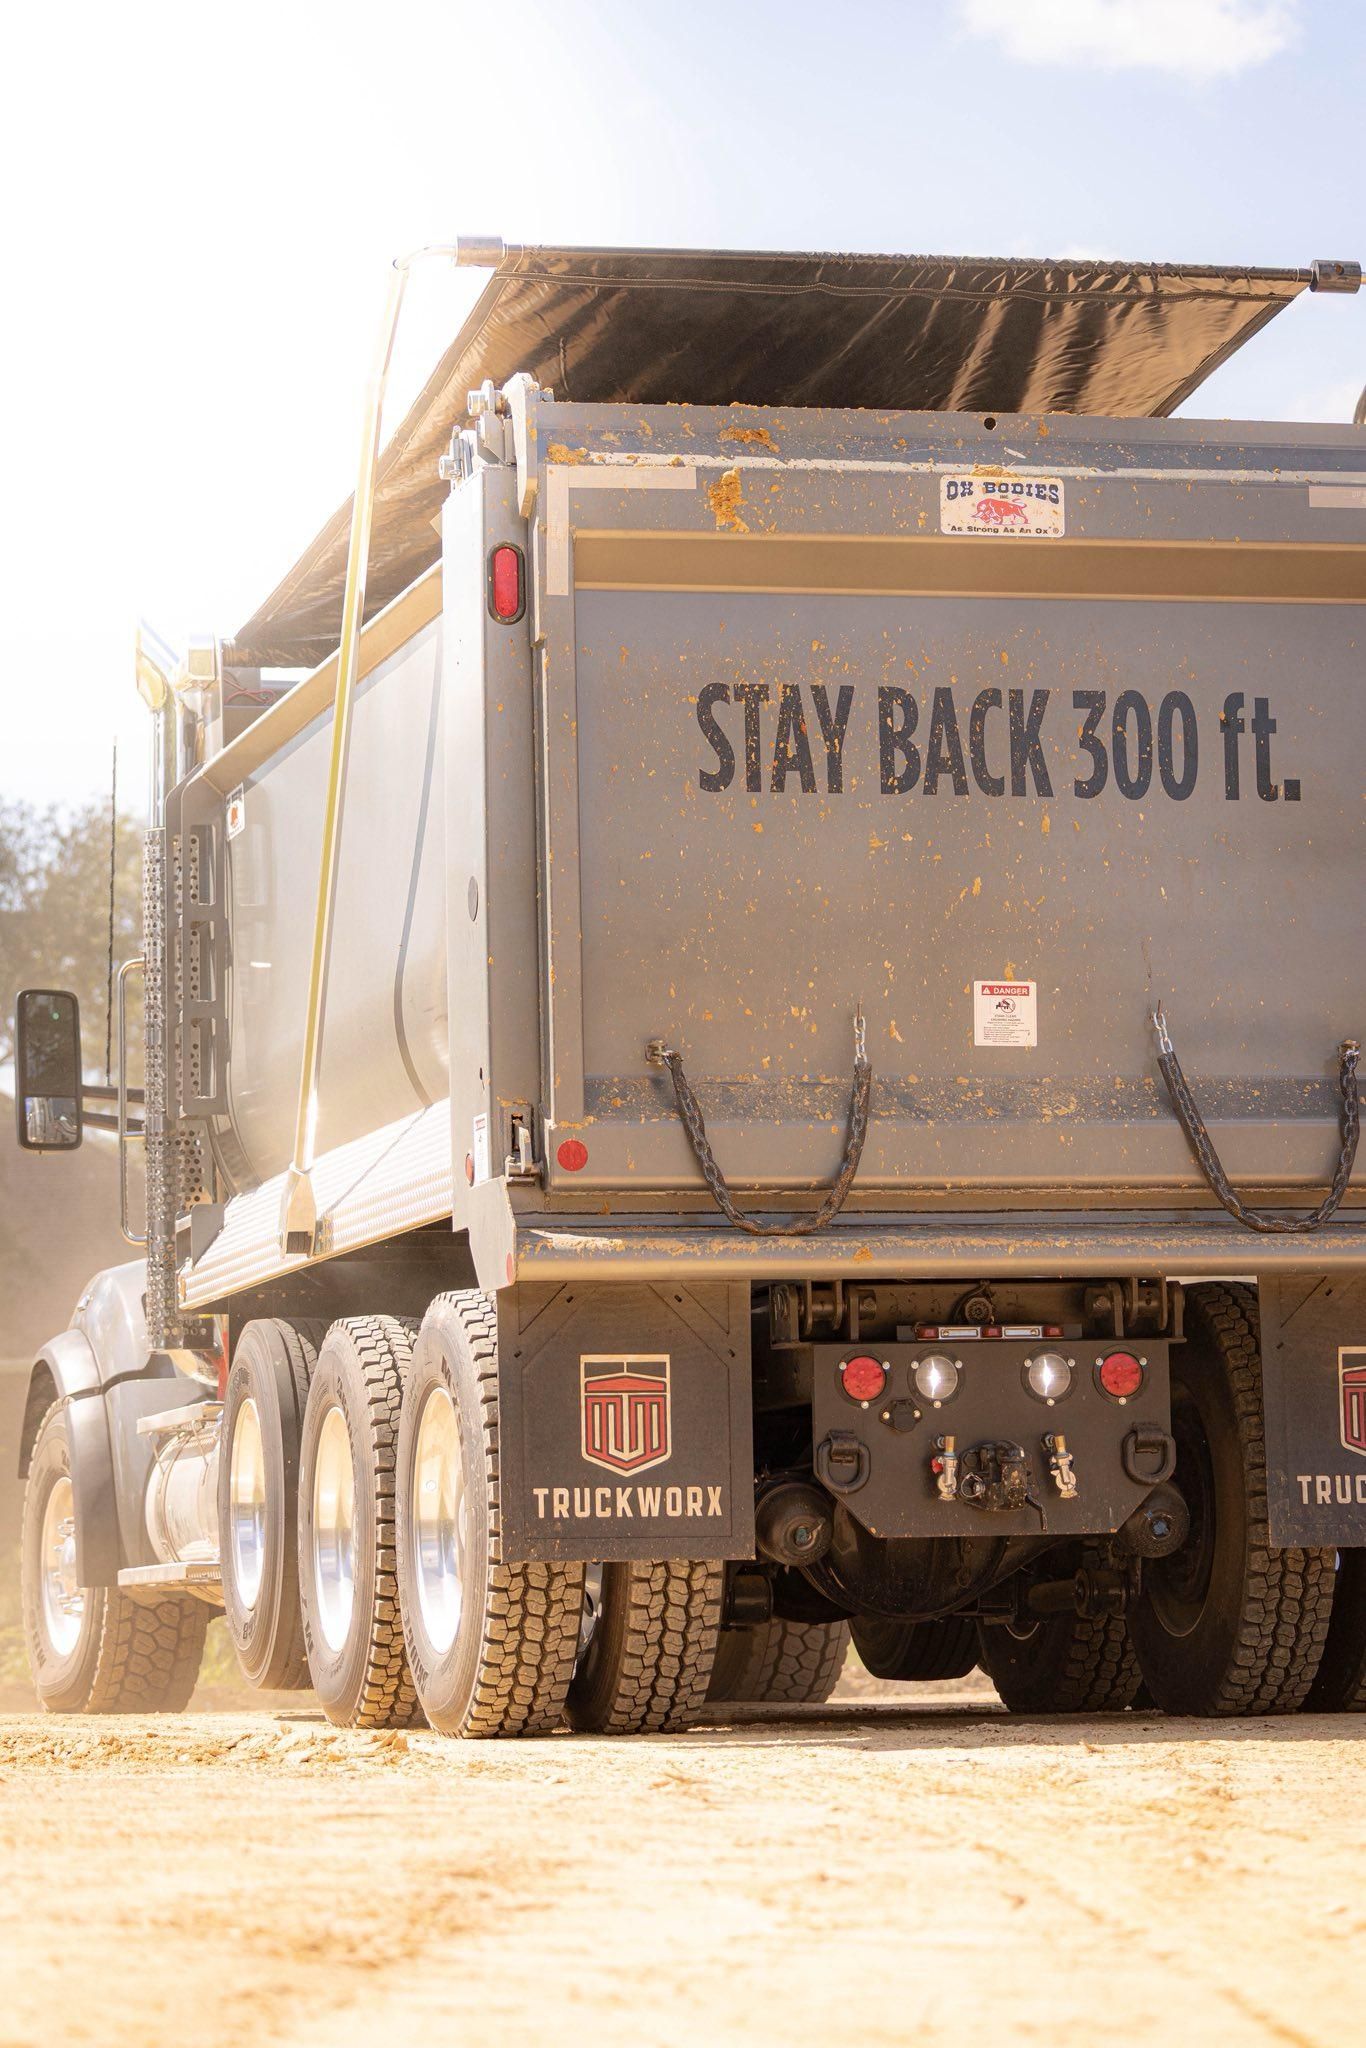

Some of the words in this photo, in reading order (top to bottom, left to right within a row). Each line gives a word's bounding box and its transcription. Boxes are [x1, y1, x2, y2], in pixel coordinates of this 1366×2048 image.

[946, 481, 973, 500] OX
[983, 482, 1059, 504] BODIES
[967, 525, 999, 534] Strong
[1003, 526, 1015, 534] As
[1020, 526, 1032, 534] An
[697, 682, 854, 794] STAY
[878, 686, 1054, 798] BACK
[1072, 689, 1198, 801] 300
[1219, 692, 1301, 802] ft.
[993, 987, 1028, 995] DANGER
[533, 1486, 722, 1519] TRUCKWORX
